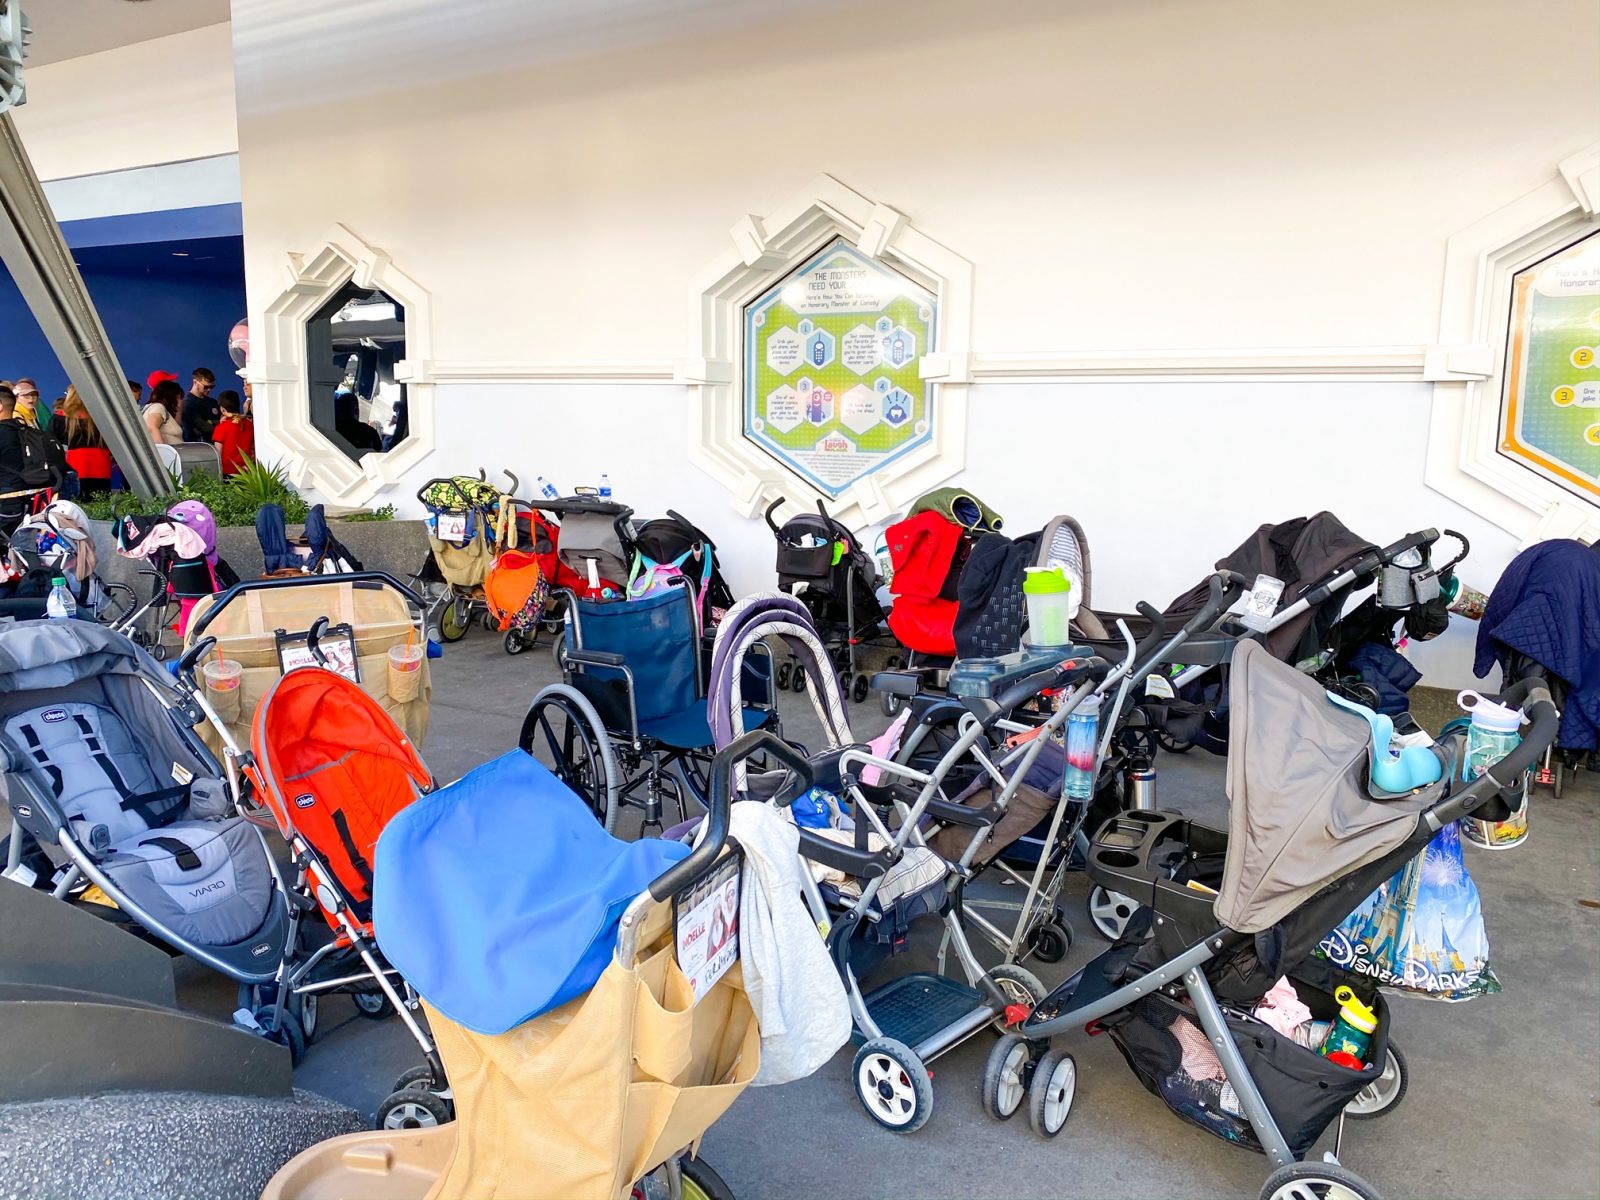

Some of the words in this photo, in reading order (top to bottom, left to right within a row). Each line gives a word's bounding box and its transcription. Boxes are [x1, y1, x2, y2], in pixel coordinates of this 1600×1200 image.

[814, 272, 827, 281] THE
[830, 270, 867, 280] MONSTERS
[808, 282, 826, 291] NEED
[829, 280, 846, 290] YOUR
[881, 322, 887, 330] 2
[824, 439, 848, 452] Laugh
[188, 880, 226, 898] VIARO
[683, 923, 706, 949] NOELLE
